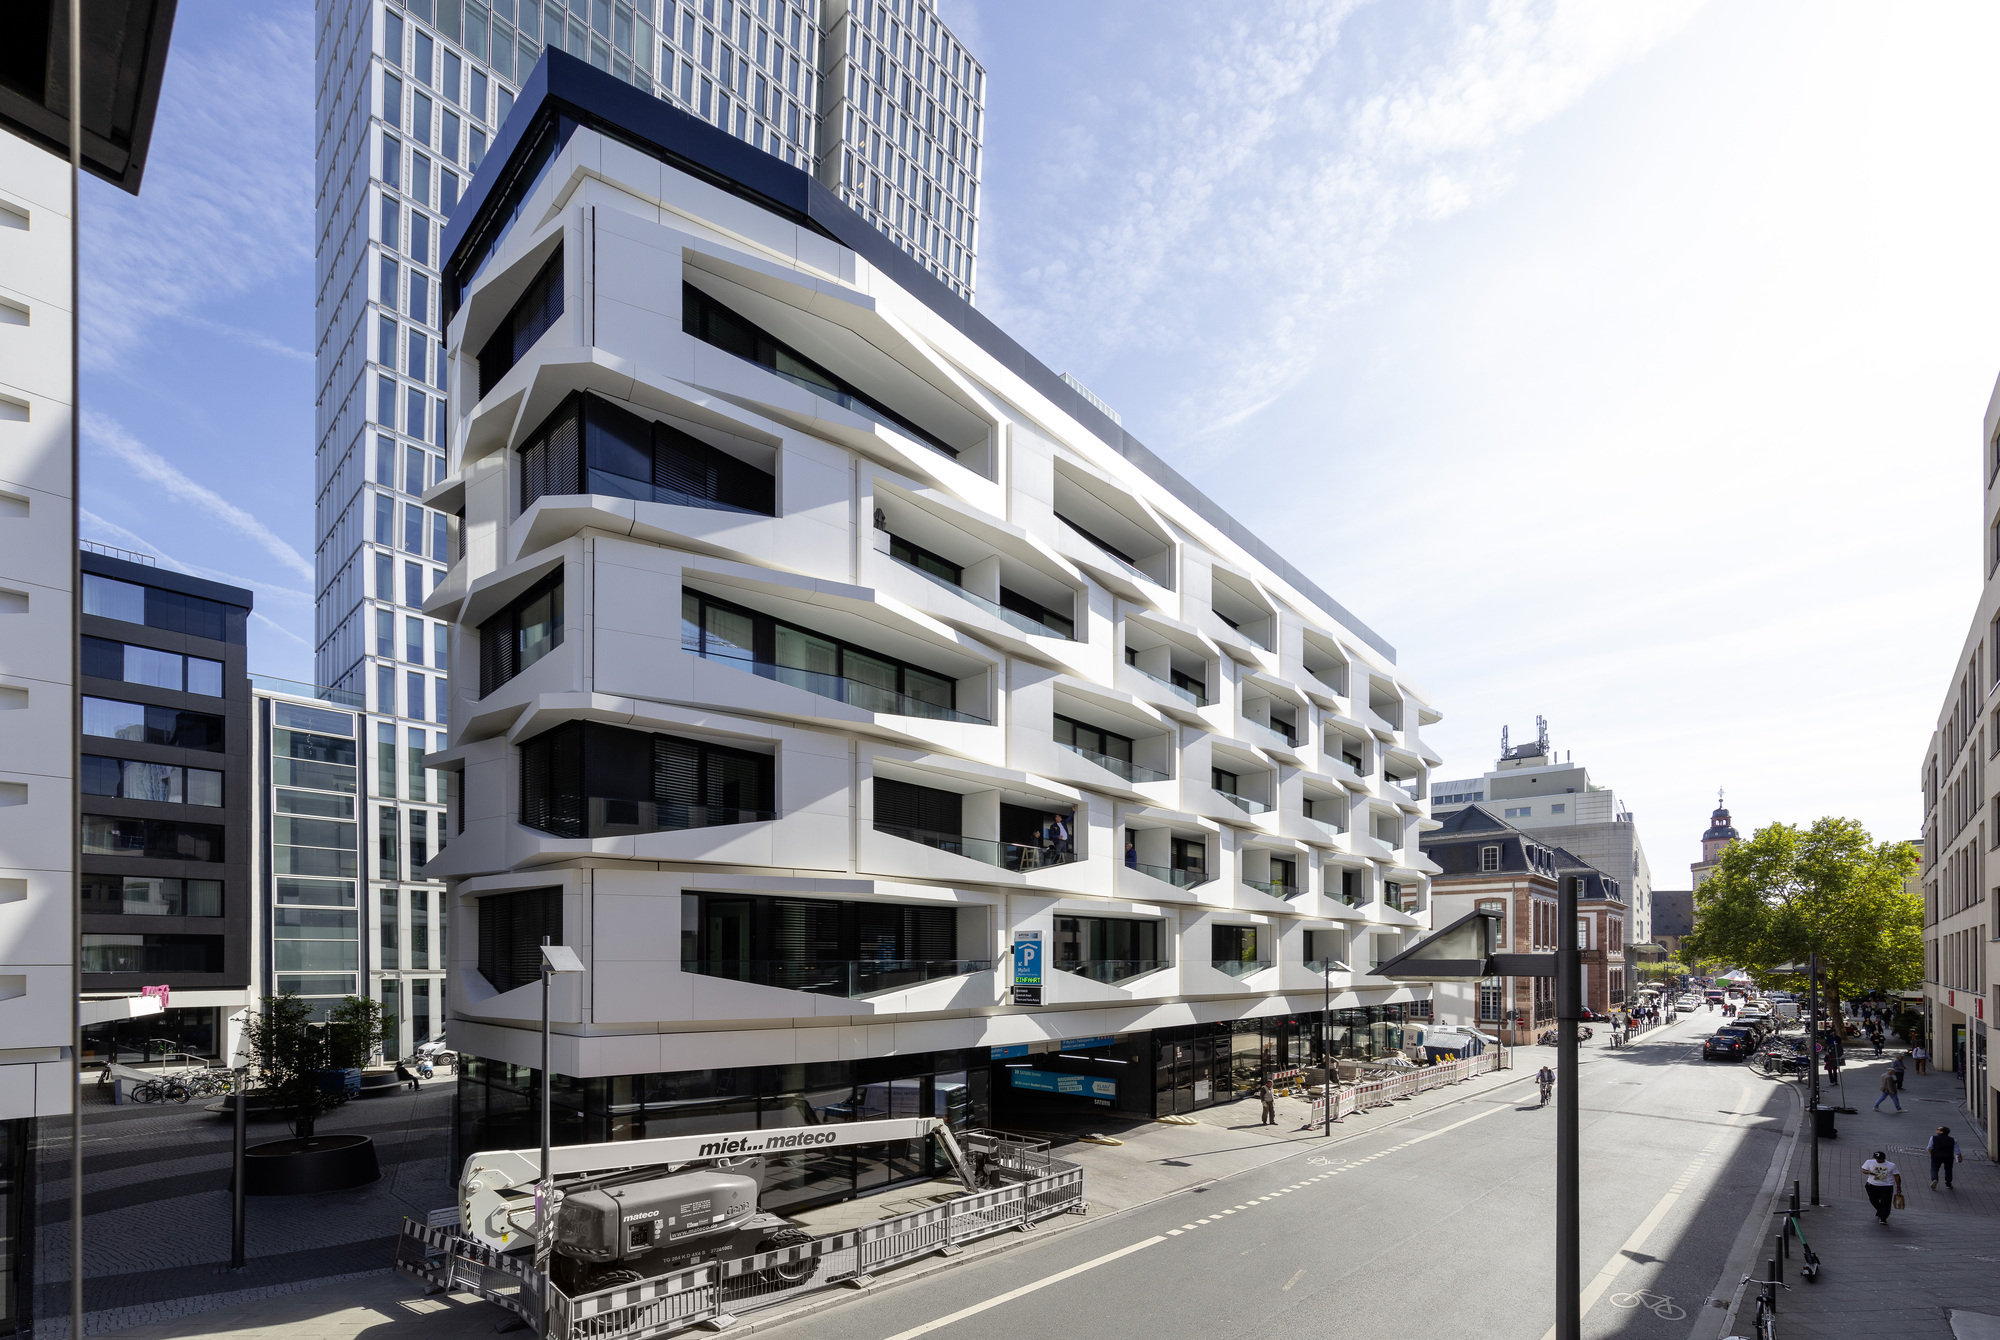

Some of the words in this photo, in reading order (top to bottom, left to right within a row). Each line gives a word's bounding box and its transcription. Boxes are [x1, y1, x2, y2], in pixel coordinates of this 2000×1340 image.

[1024, 948, 1035, 966] P
[623, 1210, 660, 1223] mateco
[671, 1223, 719, 1238] www.mateco.de
